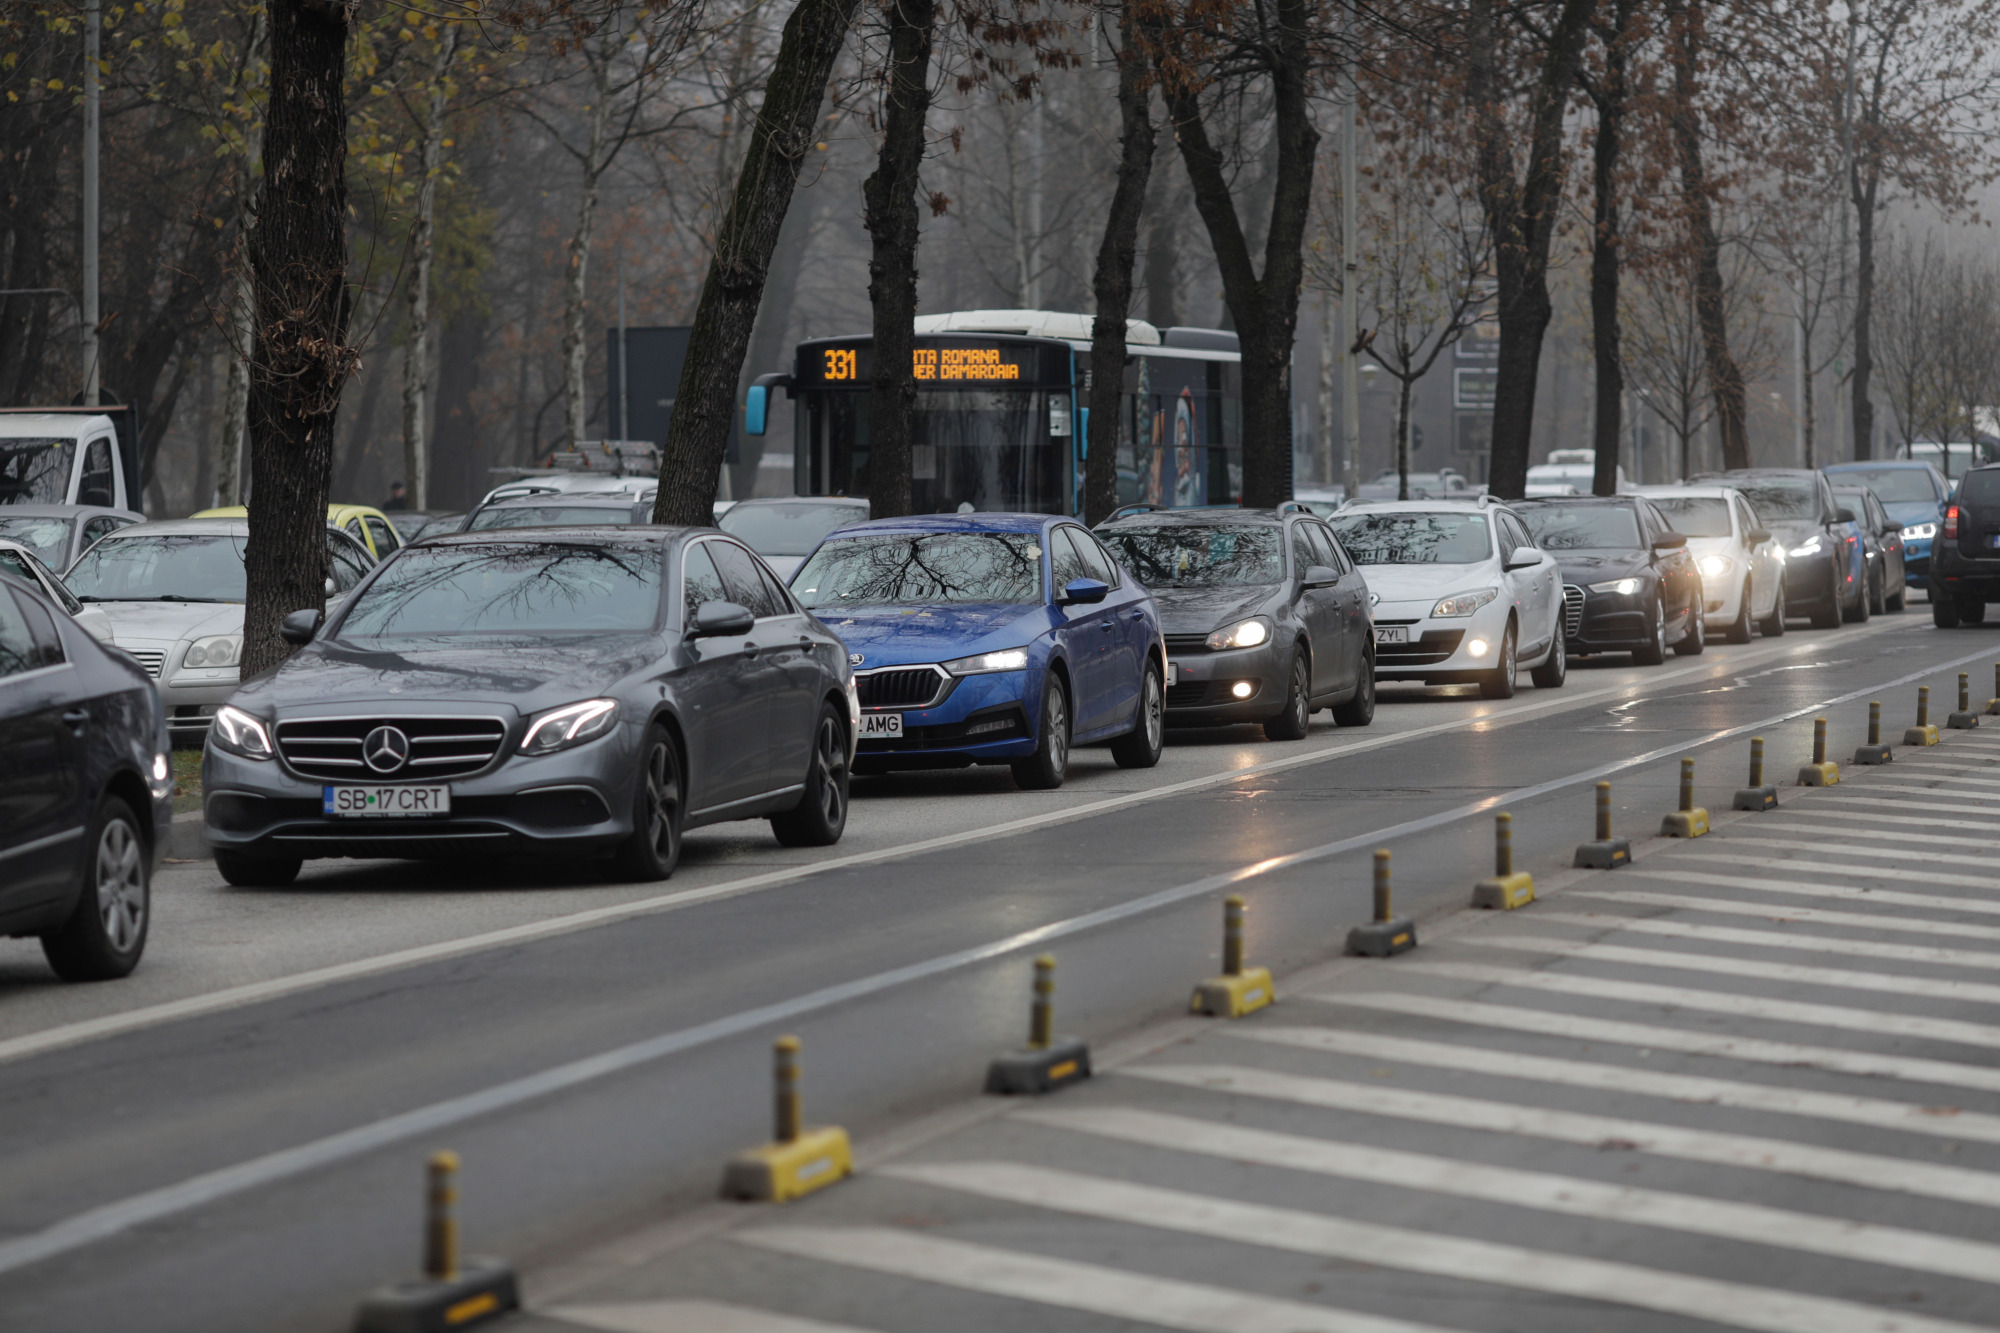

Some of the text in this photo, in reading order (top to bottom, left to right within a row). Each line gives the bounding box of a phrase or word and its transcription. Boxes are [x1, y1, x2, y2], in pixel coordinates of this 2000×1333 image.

[825, 350, 856, 379] 331
[941, 350, 999, 364] ROMANA
[940, 365, 1019, 379] DAMAROAIA
[1377, 630, 1402, 641] ZYL
[866, 716, 899, 732] AMG
[338, 789, 442, 810] SB 17 CRT
